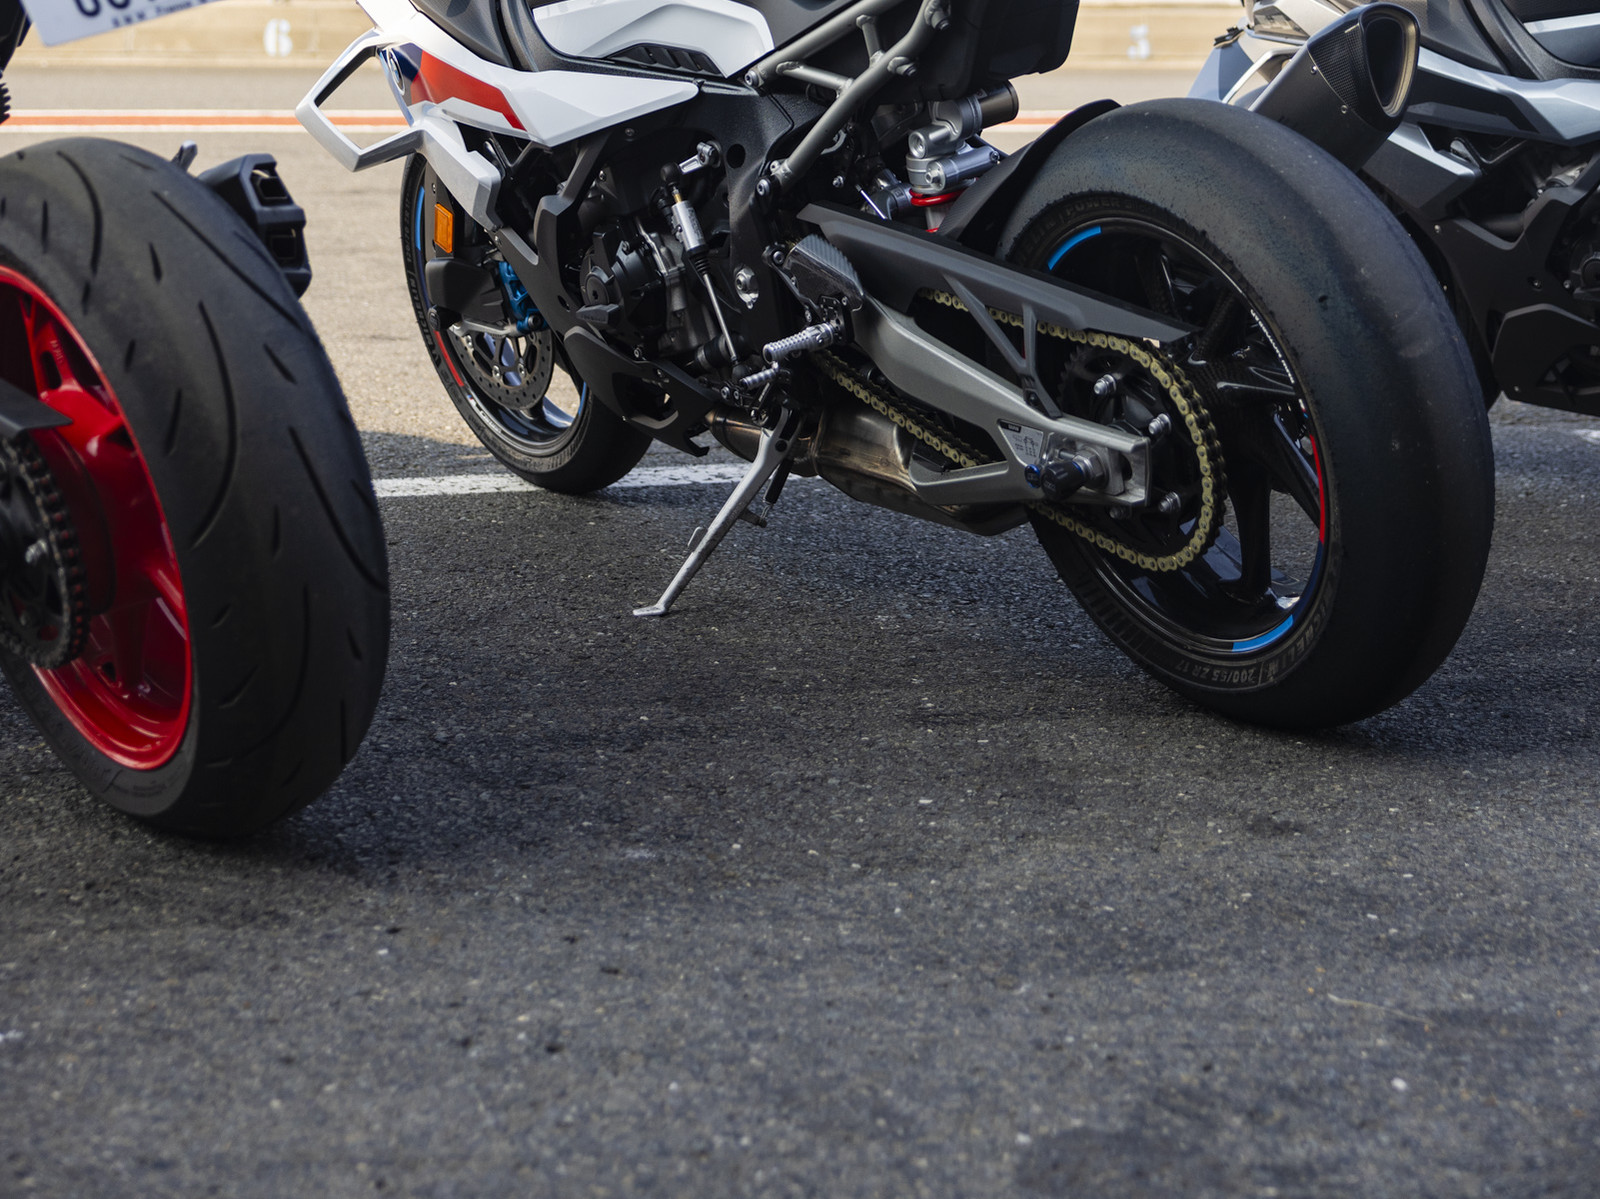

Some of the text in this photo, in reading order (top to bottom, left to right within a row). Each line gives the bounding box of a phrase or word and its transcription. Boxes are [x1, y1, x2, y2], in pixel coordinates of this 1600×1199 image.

[263, 18, 294, 58] 6
[409, 277, 433, 346] MICHELIN
[1175, 658, 1190, 674] 17
[1192, 663, 1211, 679] ZR
[1210, 667, 1256, 685] 200/55
